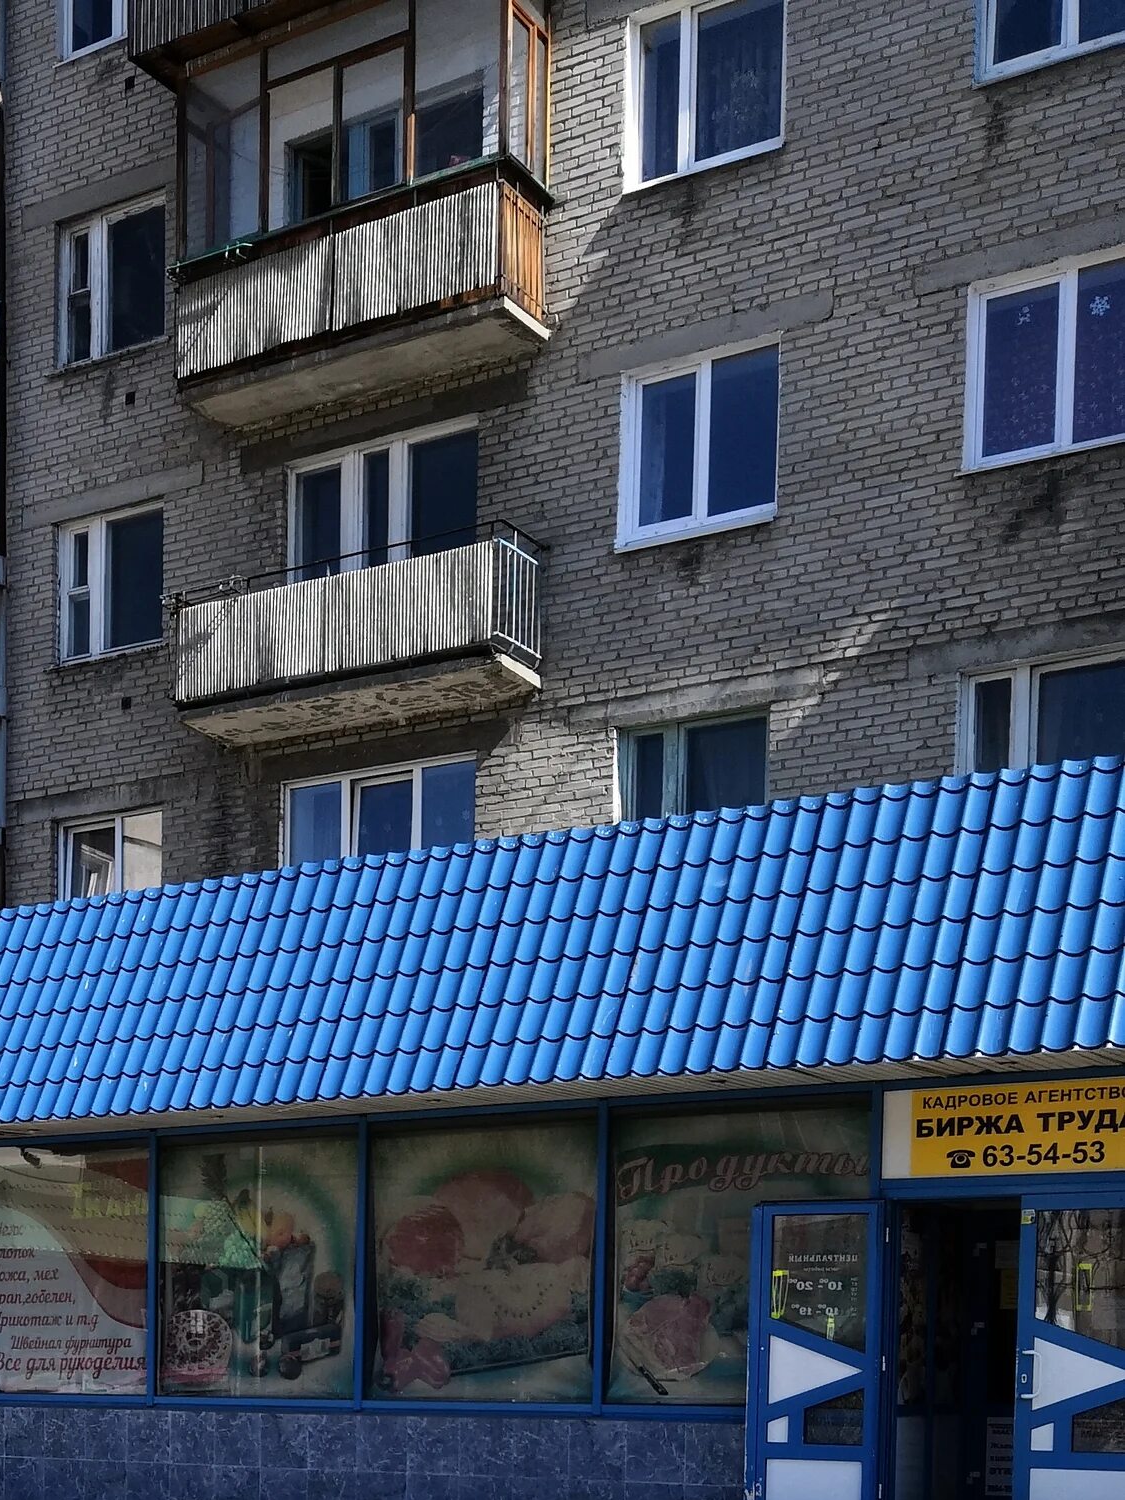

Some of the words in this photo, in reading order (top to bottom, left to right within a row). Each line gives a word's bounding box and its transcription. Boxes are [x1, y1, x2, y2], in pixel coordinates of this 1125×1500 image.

[922, 1092, 1019, 1111] КАДРОВОЕ
[1025, 1086, 1125, 1104] АГЕНТСТВ
[916, 1114, 1025, 1139] БИРЖА
[982, 1140, 1106, 1168] 63-54-53
[617, 1151, 869, 1200] Продукты
[33, 1268, 60, 1282] мех
[11, 1334, 62, 1350] Швейная
[64, 1336, 132, 1356] фурнитура
[25, 1356, 57, 1380] для
[59, 1354, 148, 1381] рукоделия
